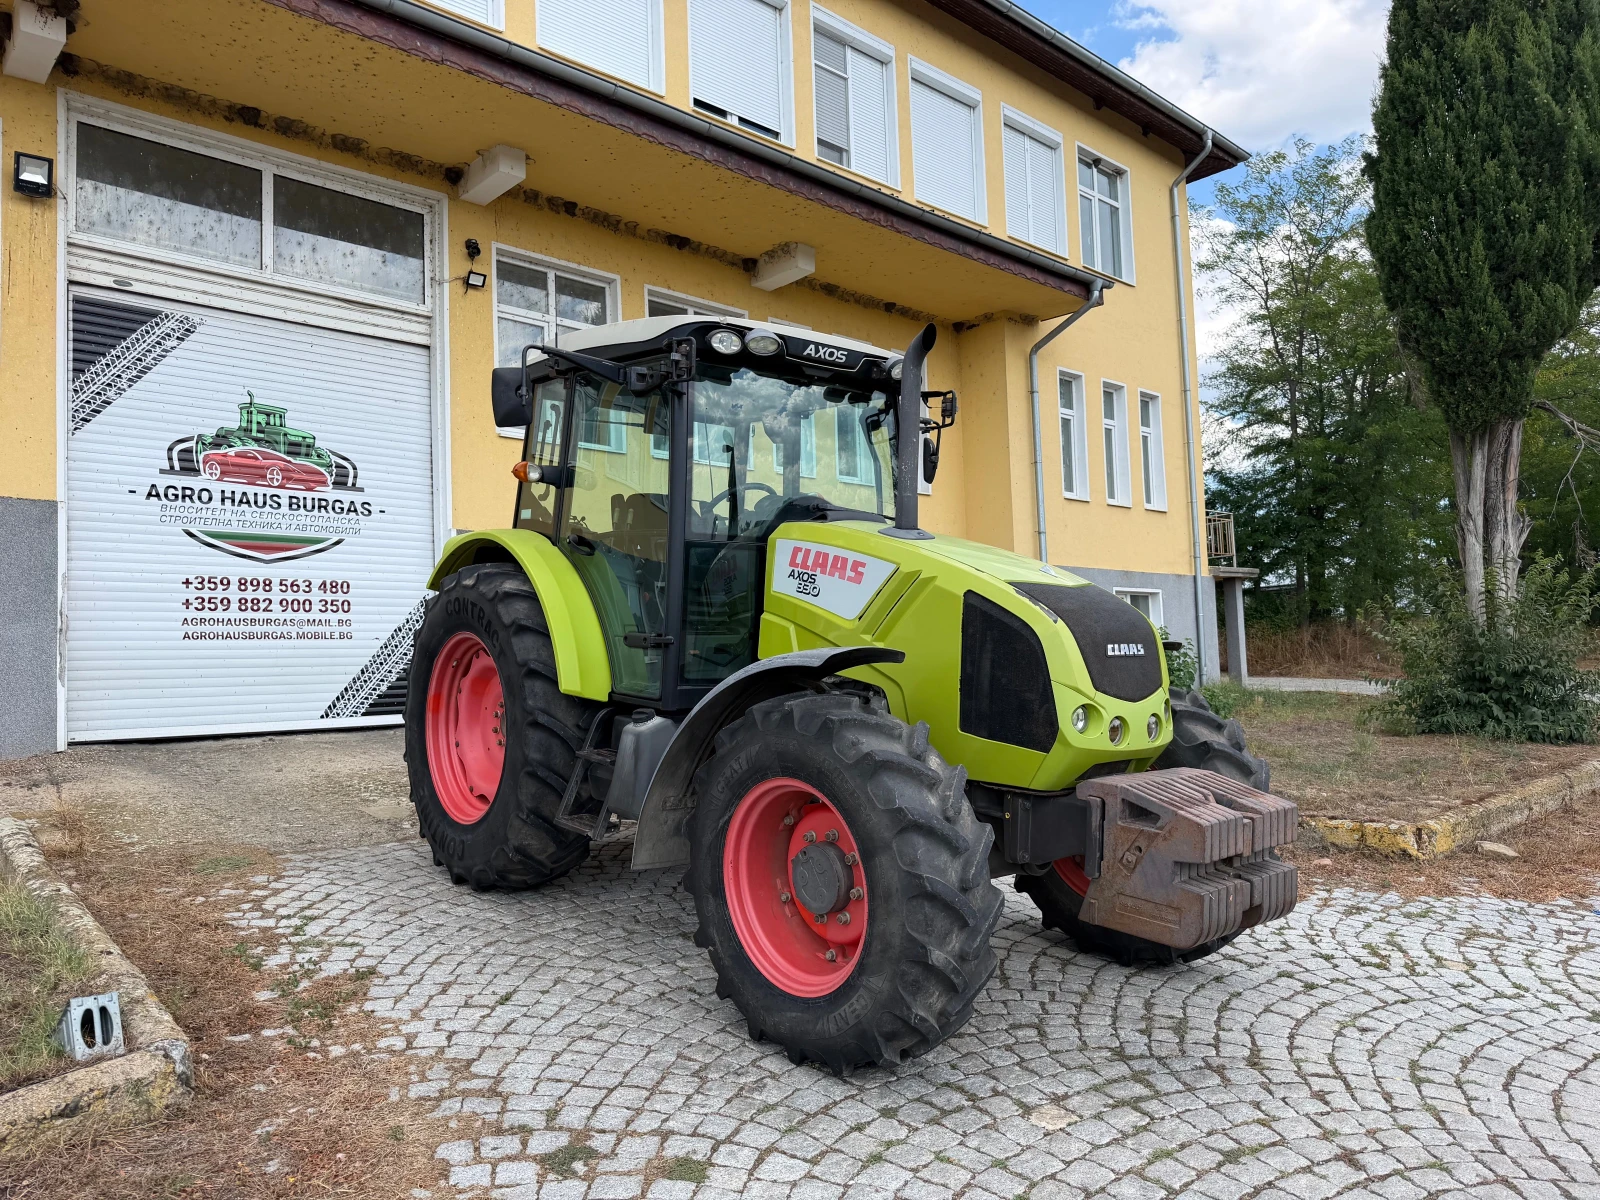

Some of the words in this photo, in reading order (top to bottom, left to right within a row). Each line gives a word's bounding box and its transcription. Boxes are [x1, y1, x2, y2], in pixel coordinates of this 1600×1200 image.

[803, 344, 848, 363] AXOS
[145, 483, 213, 505] AGRO
[220, 489, 282, 511] HAUS
[288, 495, 373, 517] BURGAS
[160, 503, 227, 517] ВНОСИТЕЛ
[230, 509, 247, 518] НА
[159, 514, 233, 528] СТРОИТЕЛНА
[236, 519, 282, 531] ТЕХНИКА
[285, 523, 292, 531] И
[294, 523, 361, 536] АВТОМОБИЛИ
[788, 545, 867, 585] CLAAS
[181, 575, 231, 592] +359
[237, 577, 273, 593] 898
[278, 578, 313, 594] 563
[317, 579, 351, 594] 480
[787, 568, 818, 584] AXOS
[181, 595, 231, 612] +359
[237, 596, 273, 613] 882
[278, 597, 313, 613] 900
[318, 598, 351, 613] 350
[181, 617, 352, 630] AGROHAUSBURGAS@MAIL.BG
[182, 631, 353, 641] AGROHAUSBURGAS.MOBILE.BG
[1106, 643, 1145, 656] CLAAS
